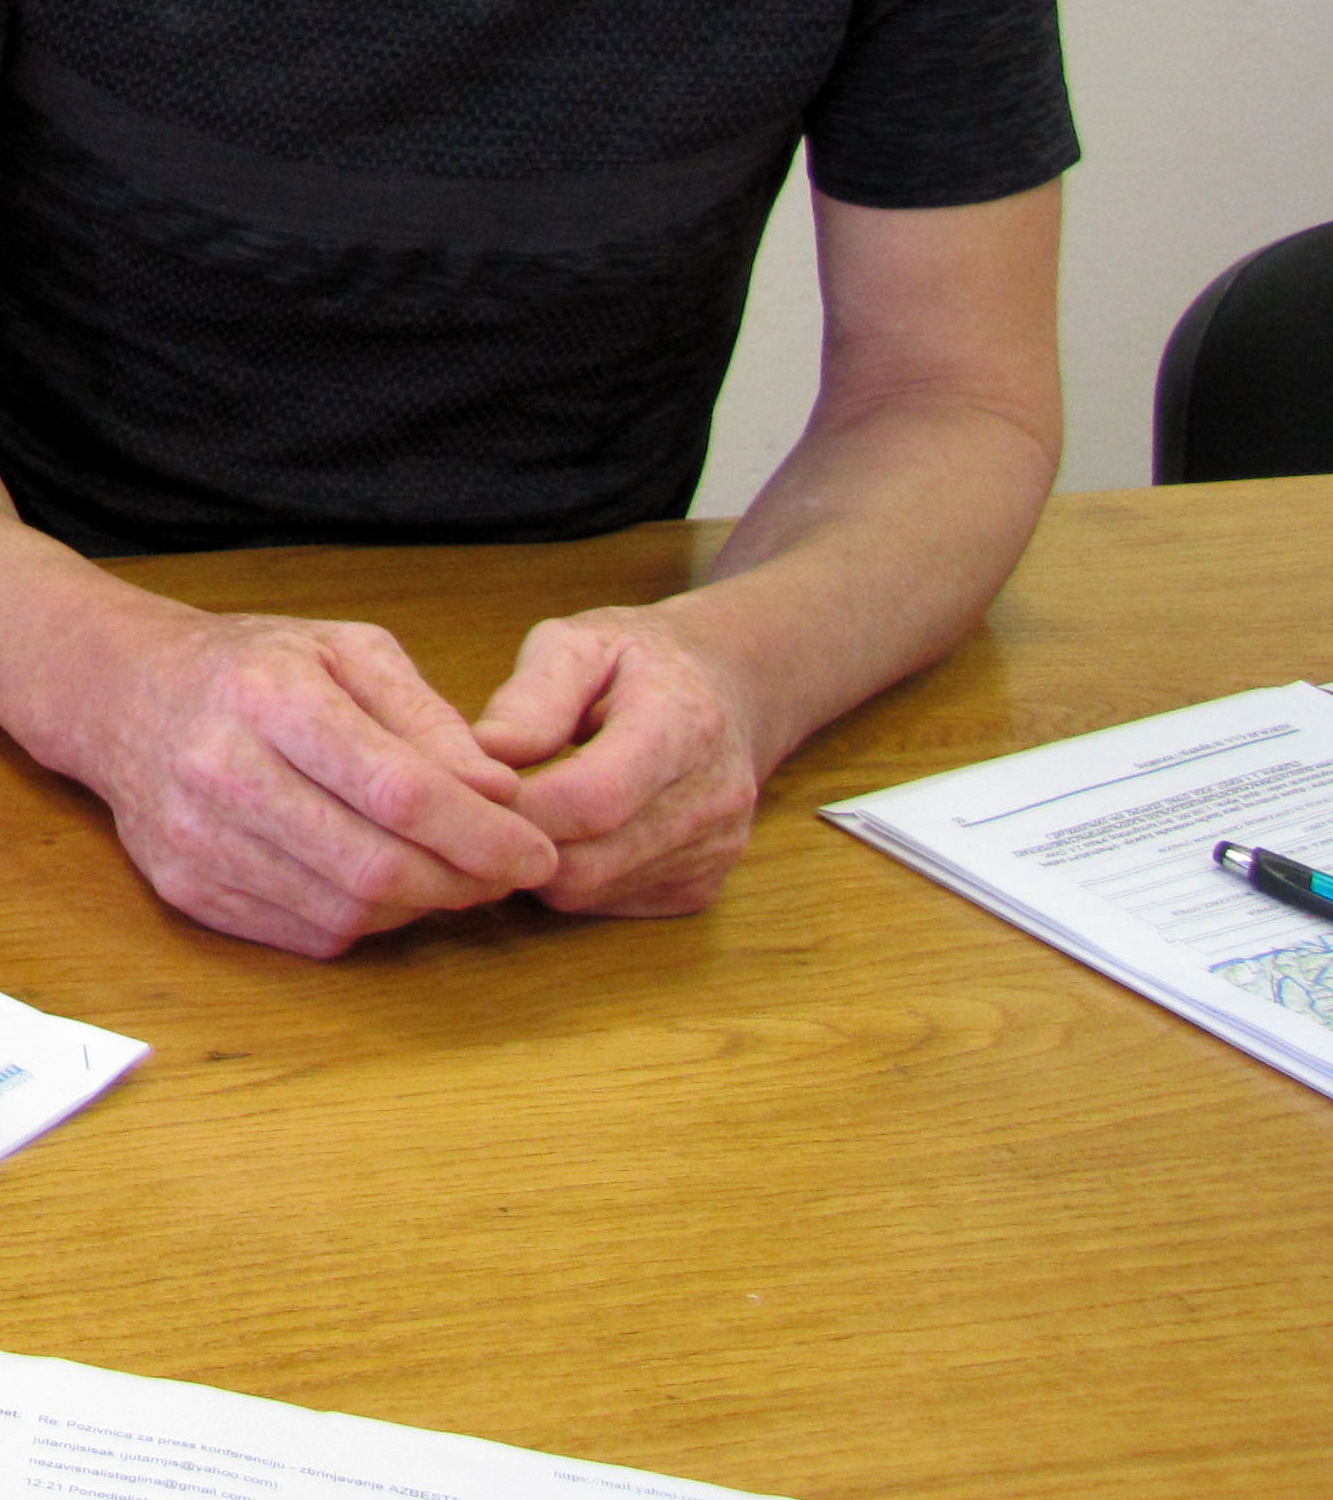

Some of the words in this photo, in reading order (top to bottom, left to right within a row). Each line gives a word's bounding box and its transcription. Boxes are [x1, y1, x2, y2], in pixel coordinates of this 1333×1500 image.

[38, 1414, 61, 1427] Re:
[66, 1419, 134, 1441] Pozivnica
[136, 1434, 155, 1444] za
[157, 1436, 198, 1451] press
[200, 1442, 286, 1470] konferenciju
[299, 1466, 386, 1492] zbrinjavanje
[24, 1476, 64, 1493] 12:21
